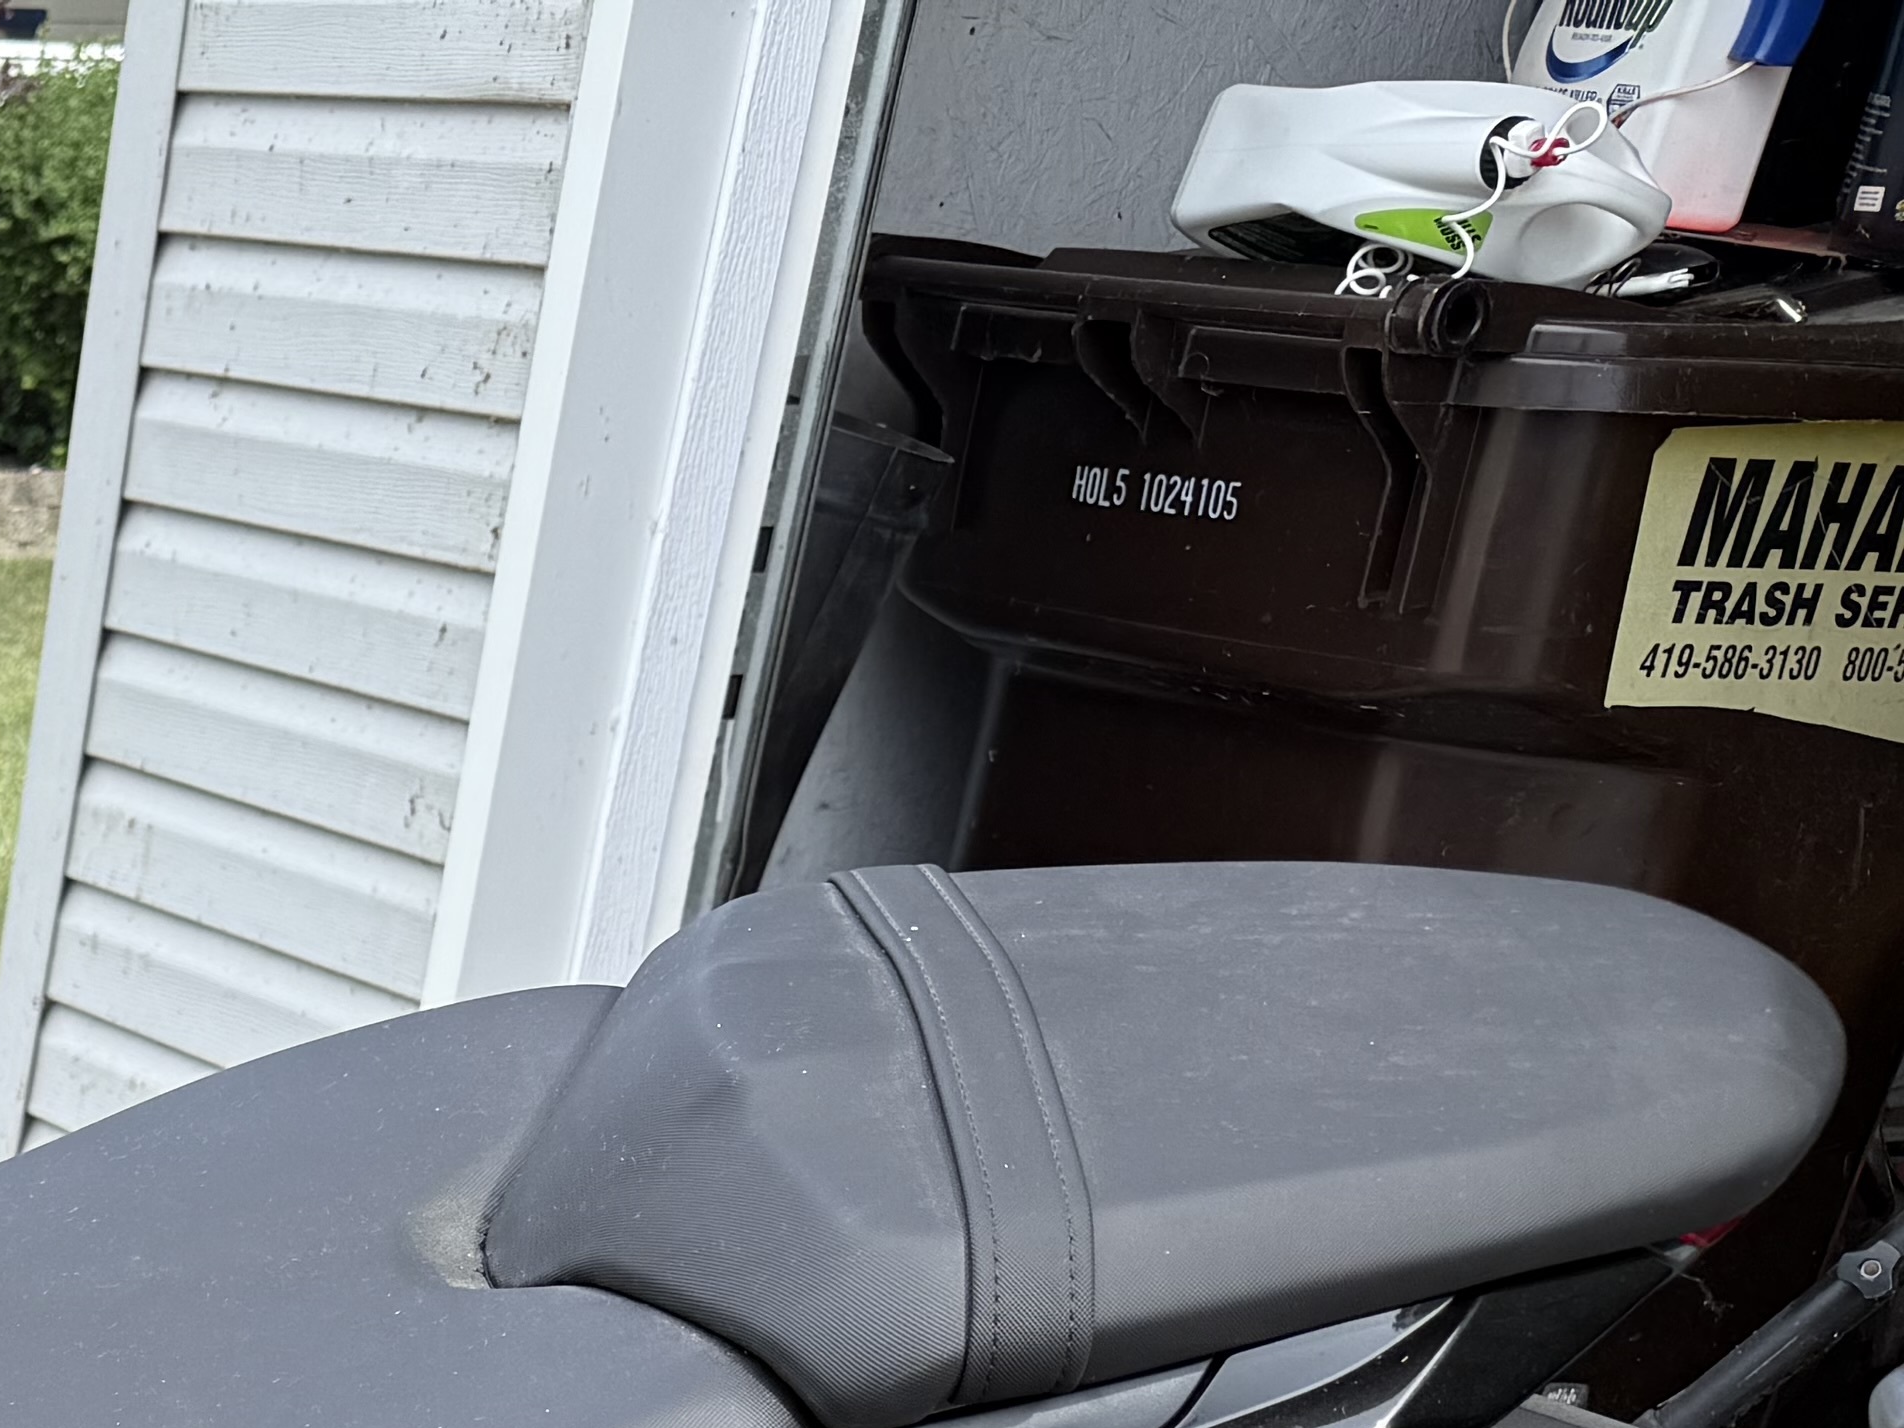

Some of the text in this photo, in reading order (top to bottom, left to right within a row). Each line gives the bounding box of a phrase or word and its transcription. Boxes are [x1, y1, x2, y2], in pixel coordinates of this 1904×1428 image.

[1140, 472, 1242, 521] 1024105
[1677, 457, 1904, 573] MAHA
[1671, 579, 1824, 627] TRASH
[1640, 643, 1822, 681] 419-586-3130
